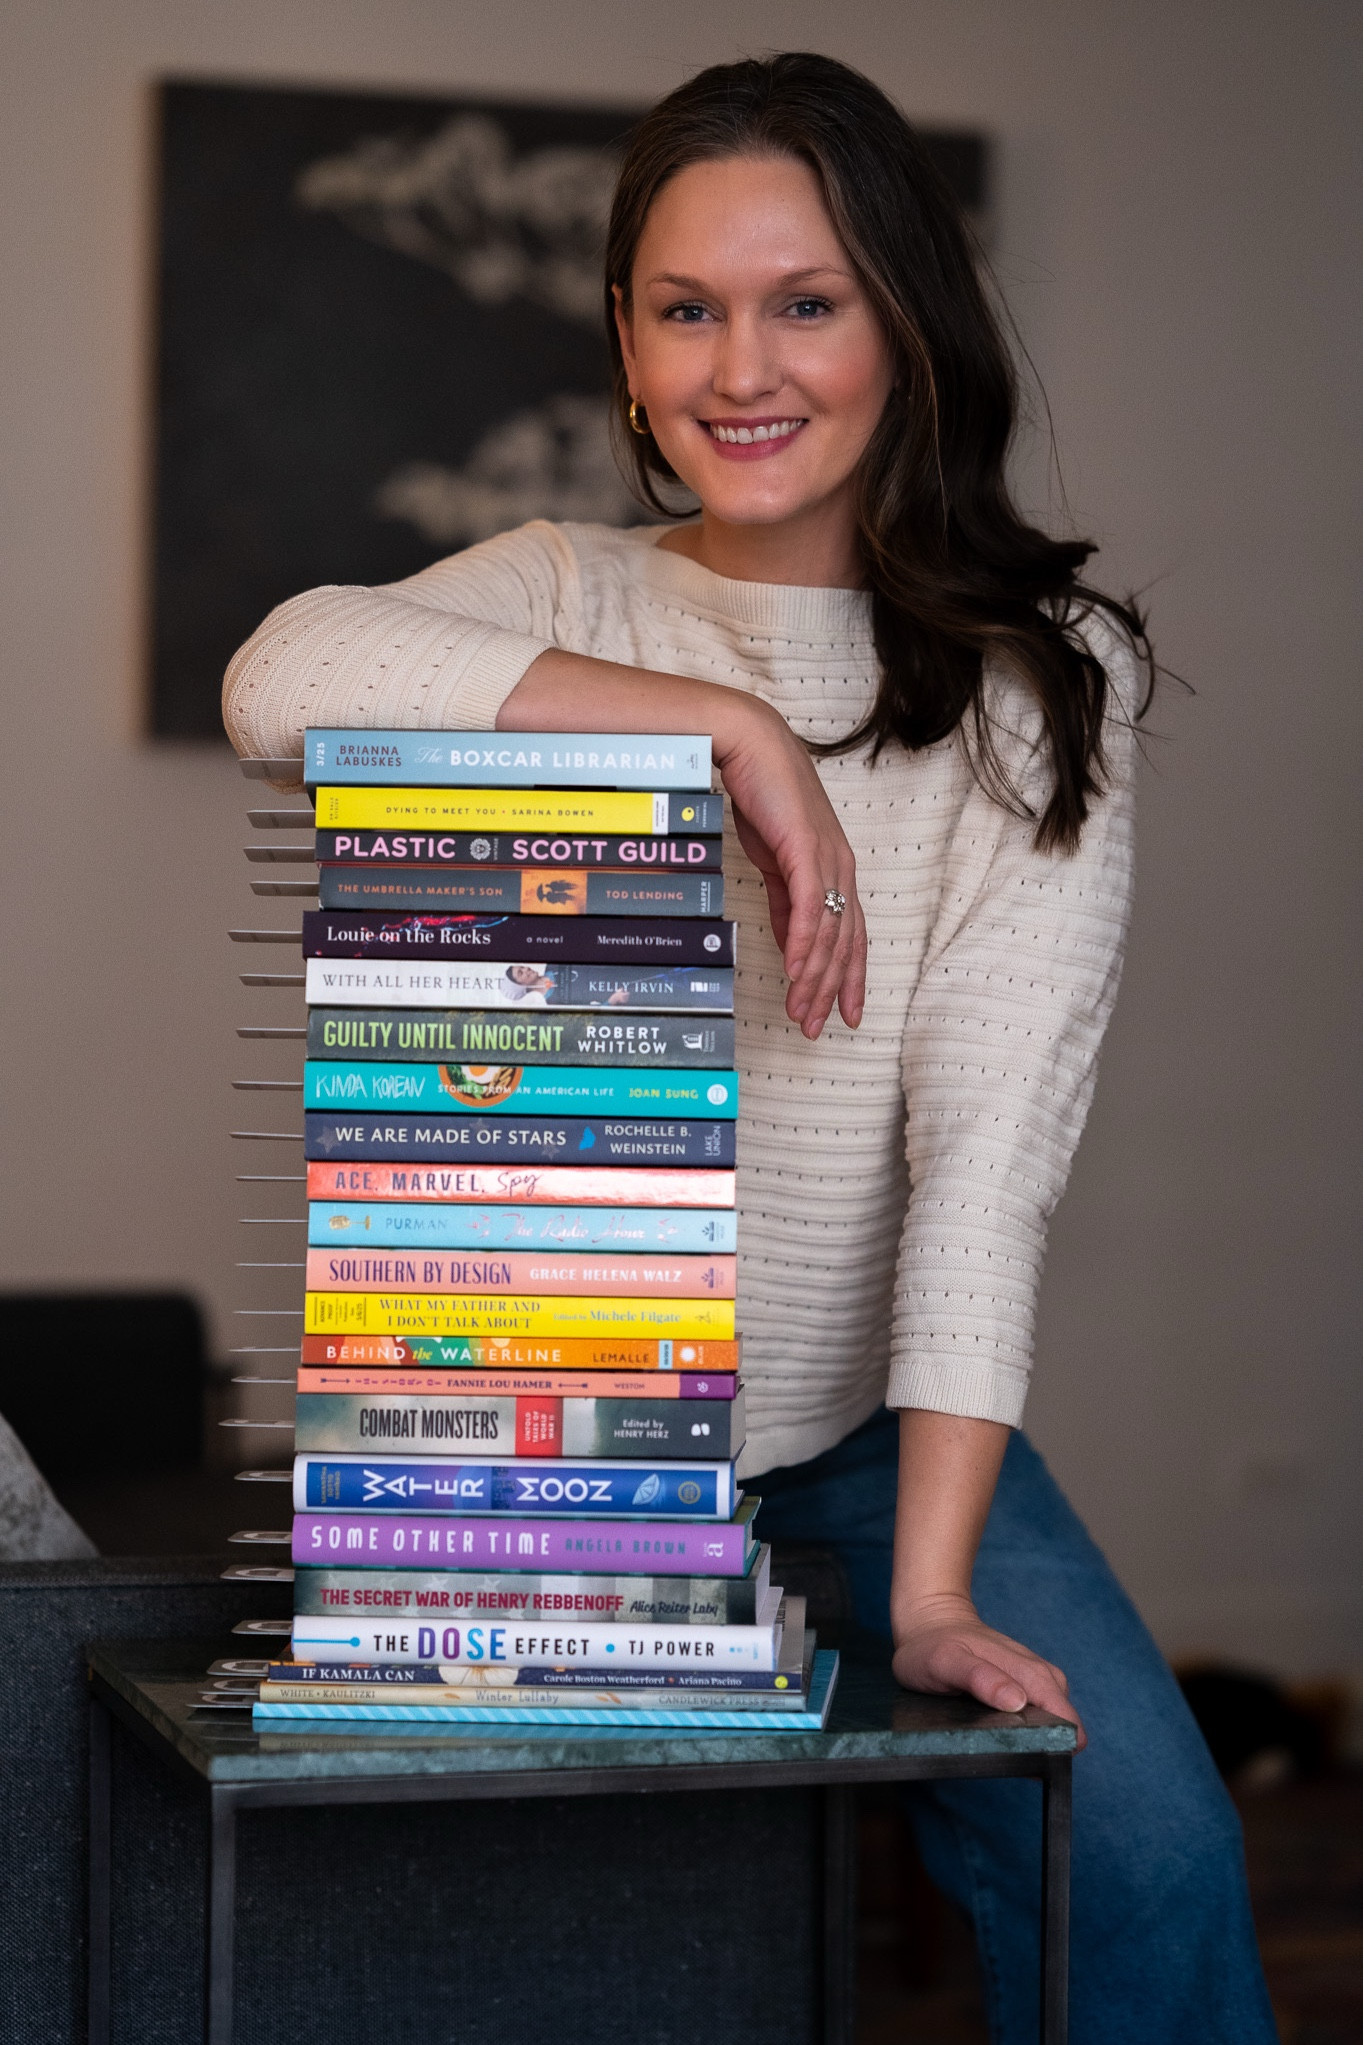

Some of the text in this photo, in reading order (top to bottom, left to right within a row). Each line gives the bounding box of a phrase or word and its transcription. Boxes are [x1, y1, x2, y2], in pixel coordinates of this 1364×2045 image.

[316, 742, 325, 767] 3/25
[340, 745, 399, 755] BRIANNA
[336, 757, 402, 767] LABUSKES
[414, 746, 443, 764] The
[450, 750, 542, 768] BOXCAR
[553, 752, 675, 770] LIBRARIAN
[335, 836, 456, 858] PLASTIC
[512, 839, 707, 863] SCOTT GUILD
[337, 884, 503, 896] THE UMBRELLA MAKER'S SON
[606, 890, 683, 900] TOD LENDING
[327, 926, 491, 945] Louie on the Rocks
[536, 936, 563, 944] novel
[597, 935, 682, 947] Meredith O'Brien
[323, 974, 505, 990] WITH ALL HER HEART
[589, 981, 674, 993] KELLY IRVIN
[324, 1021, 564, 1052] GUILTY UNTIL INNOCENT
[587, 1026, 660, 1040] ROBERT
[578, 1041, 667, 1054] WHITLOW
[316, 1073, 425, 1099] KINDA KOREAN
[437, 1084, 614, 1096] STORIES FROM AN AMERICAN LIFE
[629, 1088, 698, 1099] JOAN SUNG
[336, 1127, 566, 1145] WE ARE MADE OF STARS
[604, 1125, 692, 1137] ROCHELLE B.
[713, 1125, 721, 1156] UNION
[610, 1143, 686, 1155] WEINSTEIN
[336, 1172, 544, 1197] ACE. MARVEL. Spy
[386, 1218, 448, 1230] PURMAN
[502, 1213, 645, 1243] The Radio Hour
[329, 1259, 511, 1284] SOUTHERN BY DESIGN
[530, 1268, 682, 1283] GRACE HELENA WALZ
[380, 1299, 540, 1312] WHAT MY FATHER AND
[387, 1316, 532, 1329] I DON'T TALK ABOUT
[553, 1310, 681, 1324] Edited by Michele Filgate
[327, 1346, 561, 1362] BEHIND the WATERLINE
[593, 1353, 649, 1363] LEMALLE
[447, 1380, 552, 1389] FANNIE LOU HAMER
[533, 1411, 539, 1420] OF
[360, 1408, 499, 1439] COMBAT MONSTERS
[623, 1419, 664, 1430] Edited by
[614, 1429, 669, 1439] HENRY HERZ
[363, 1469, 612, 1502] WATER MOON
[311, 1526, 550, 1555] SOME OTHER TIME
[565, 1538, 622, 1553] ANGELA
[633, 1540, 686, 1554] BROWN
[320, 1589, 624, 1611] THE SECRET WAR OF HENRY REBBENOFF
[630, 1601, 718, 1616] Alice Reiter Laby
[374, 1627, 590, 1661] THE DOSE EFFECT
[629, 1640, 714, 1656] TJ POWER
[302, 1669, 415, 1681] IF KAMALA CAN
[544, 1674, 665, 1685] Carole Boston Weatherford
[679, 1677, 742, 1686] Ariana Pacino
[280, 1689, 314, 1698] WHITE
[323, 1690, 375, 1699] KAULITZKI
[475, 1690, 559, 1705] Winter Lullaby
[658, 1695, 727, 1706] CANDLEWICK
